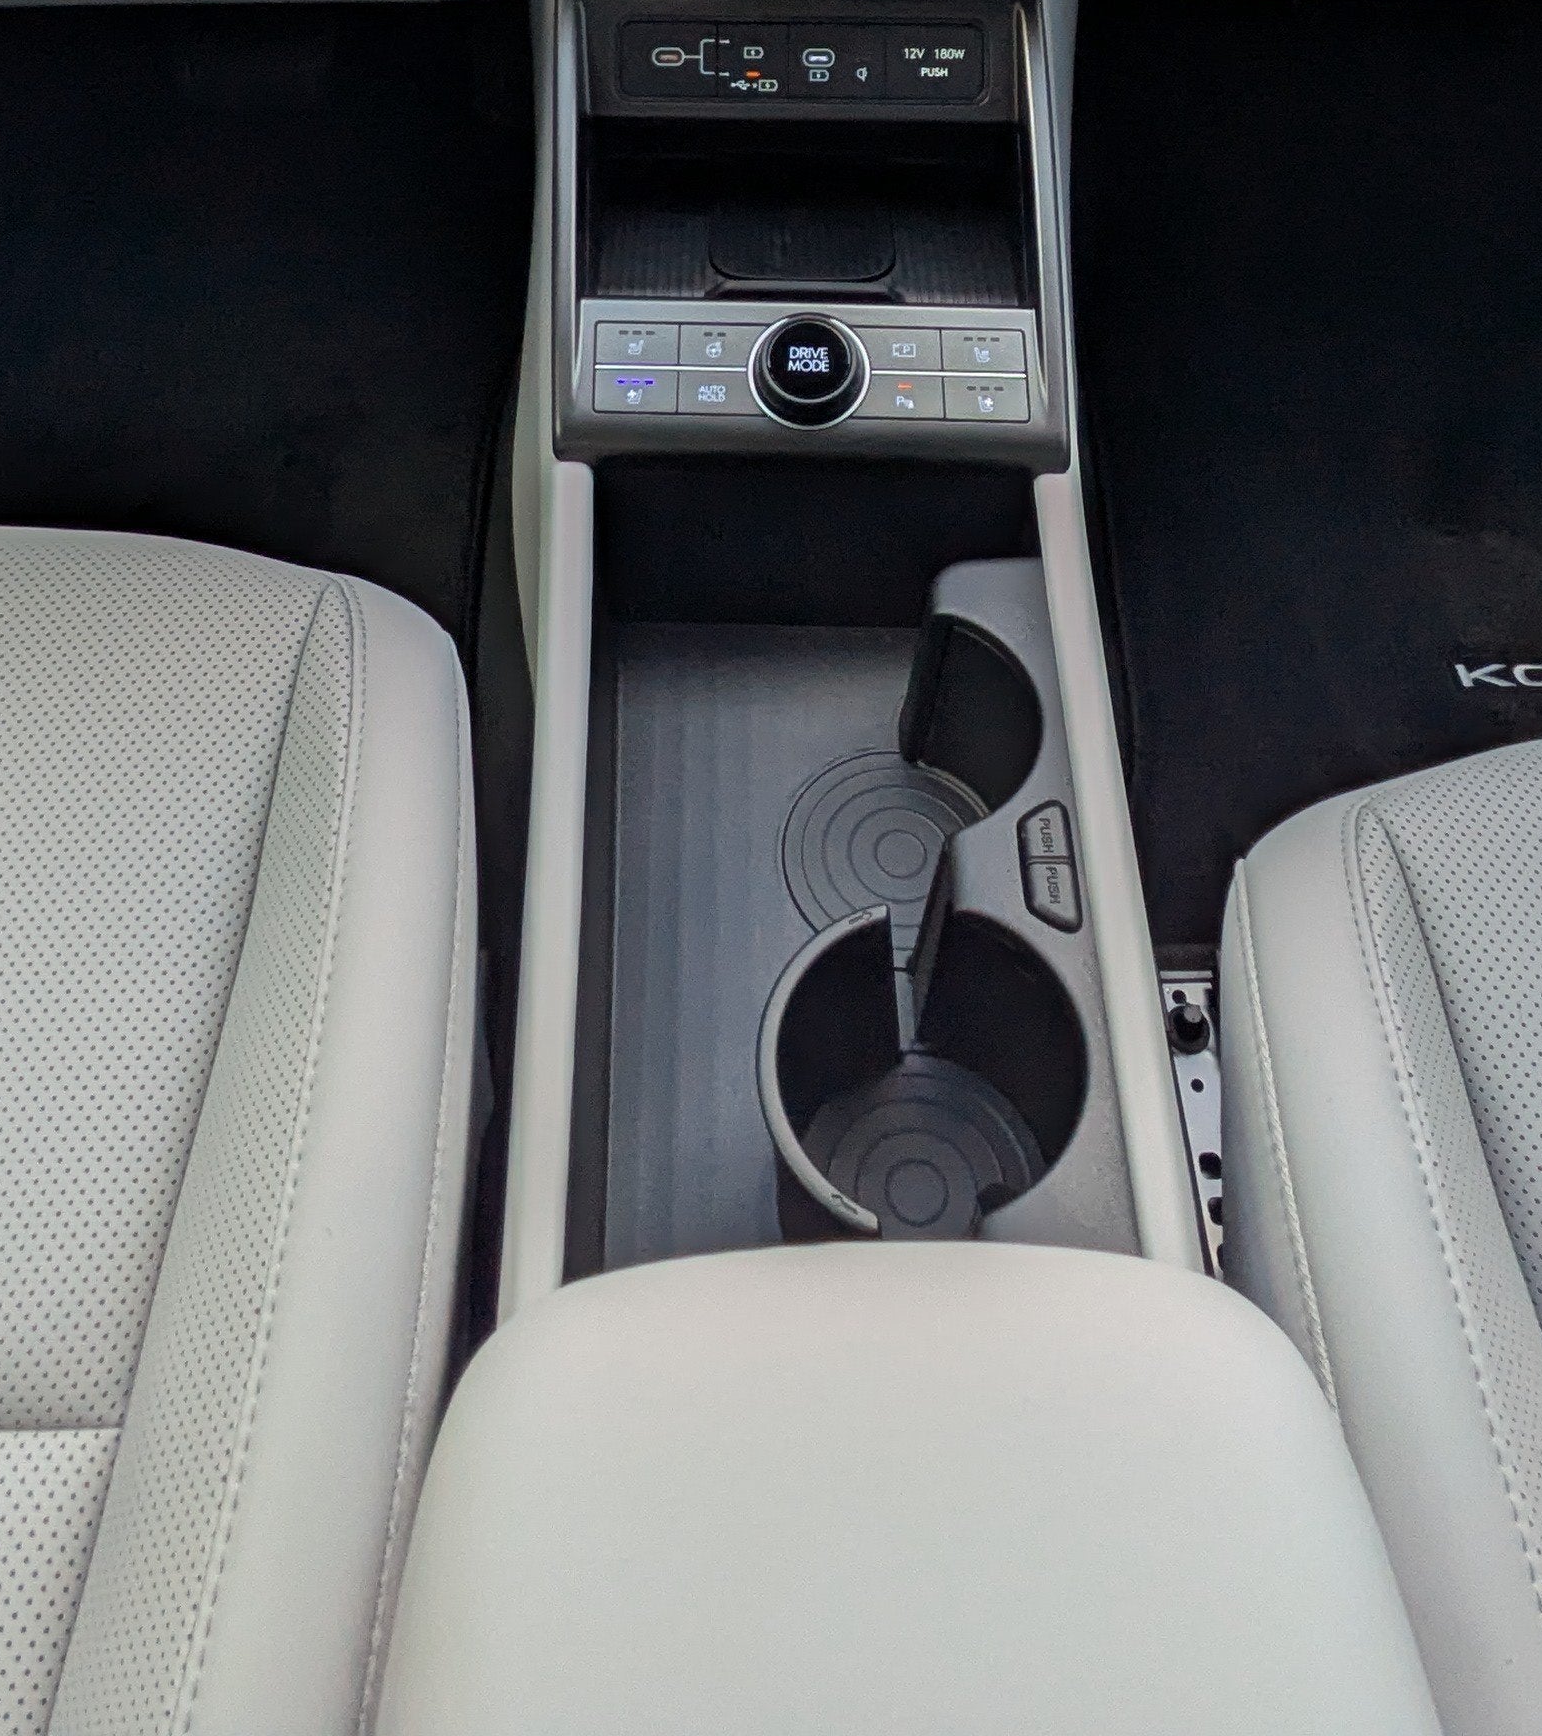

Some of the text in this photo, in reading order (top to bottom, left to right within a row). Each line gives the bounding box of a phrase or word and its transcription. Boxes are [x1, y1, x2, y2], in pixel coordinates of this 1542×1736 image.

[903, 47, 966, 60] 12V 180W
[920, 67, 949, 77] PUSH
[788, 346, 829, 360] DRIVE
[787, 360, 830, 373] MODE
[698, 384, 727, 395] AUTO
[698, 393, 727, 403] HOLD
[1039, 817, 1055, 854] PUSH
[1045, 866, 1061, 905] PUSH
